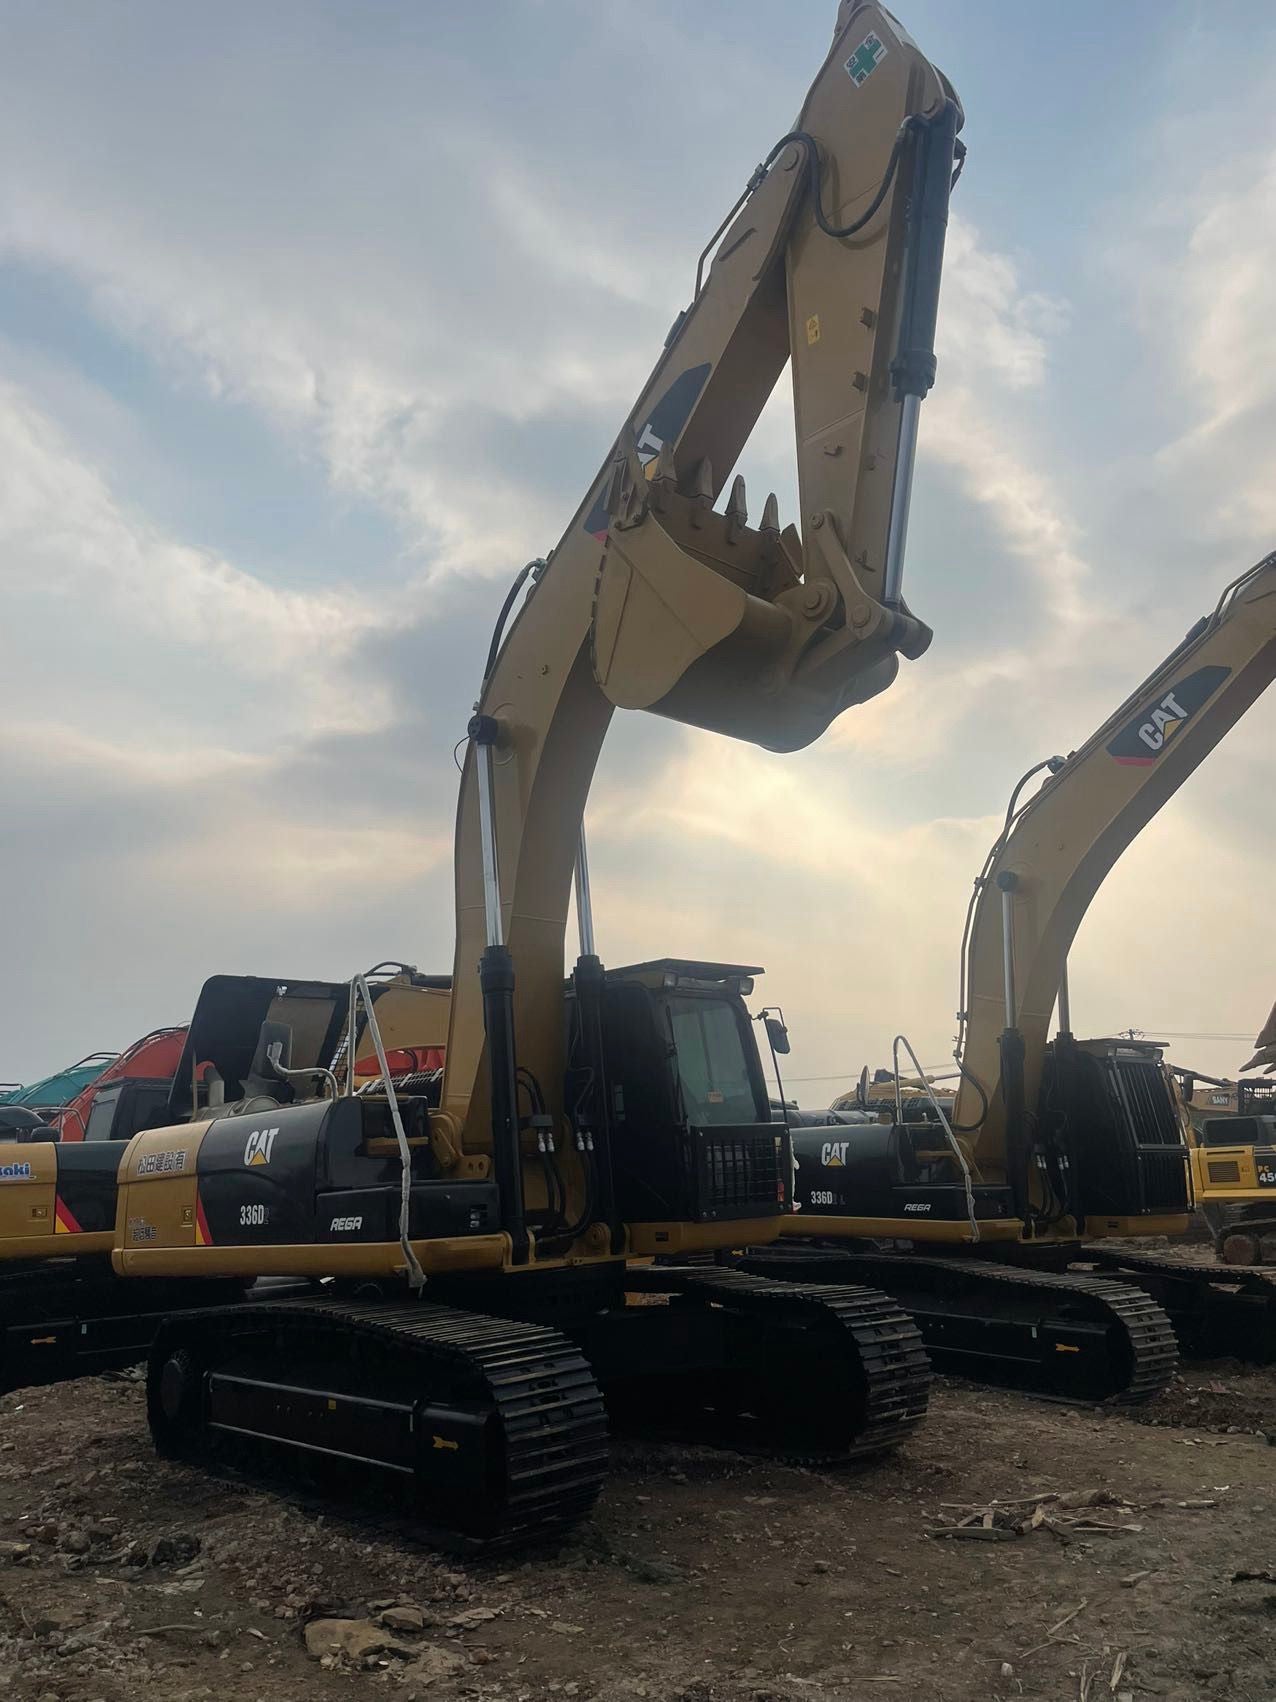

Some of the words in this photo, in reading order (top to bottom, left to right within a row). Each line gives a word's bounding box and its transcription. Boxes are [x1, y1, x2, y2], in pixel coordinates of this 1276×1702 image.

[1138, 692, 1188, 750] CAT
[244, 1127, 279, 1166] CAT
[821, 1142, 849, 1166] CAT
[1259, 1172, 1276, 1182] 45
[904, 1203, 932, 1212] REGA
[330, 1216, 363, 1231] REGA
